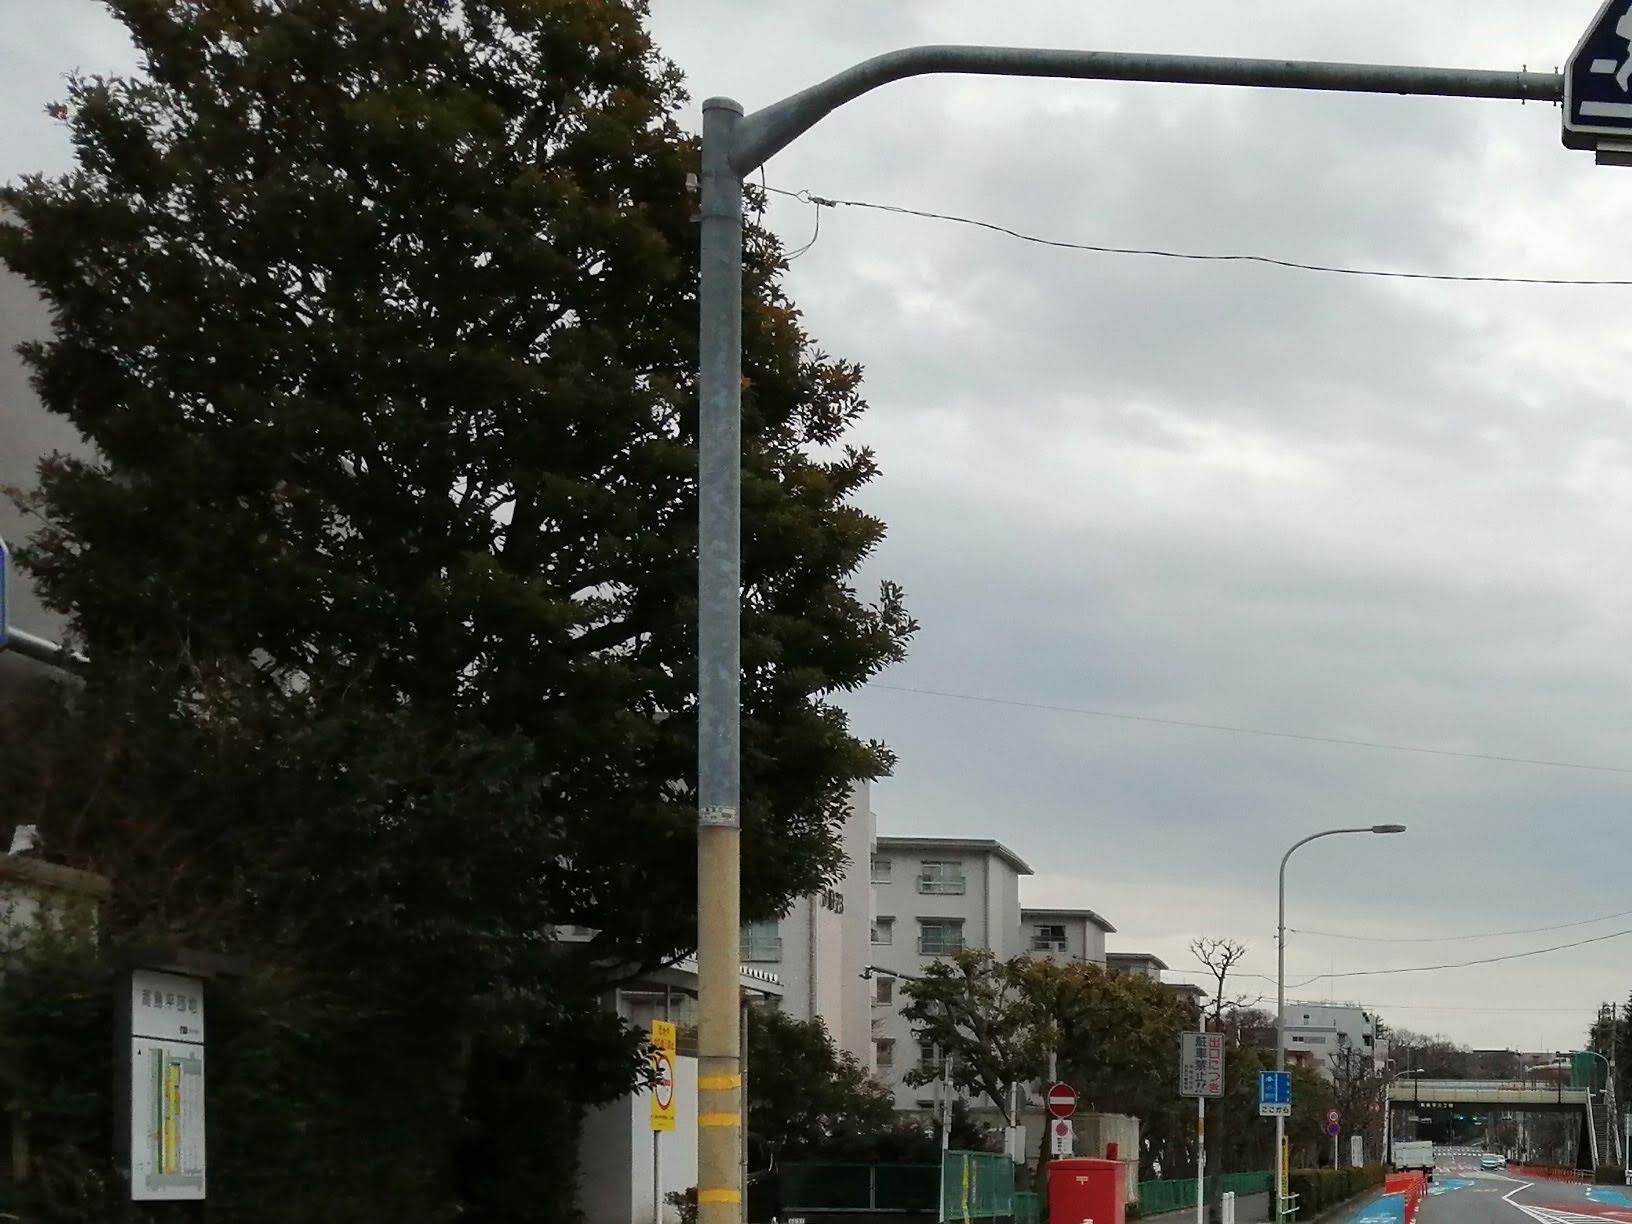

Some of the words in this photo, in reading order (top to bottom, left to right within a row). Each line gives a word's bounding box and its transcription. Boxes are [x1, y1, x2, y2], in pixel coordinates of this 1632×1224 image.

[1208, 1036, 1221, 1094] 出口につき
